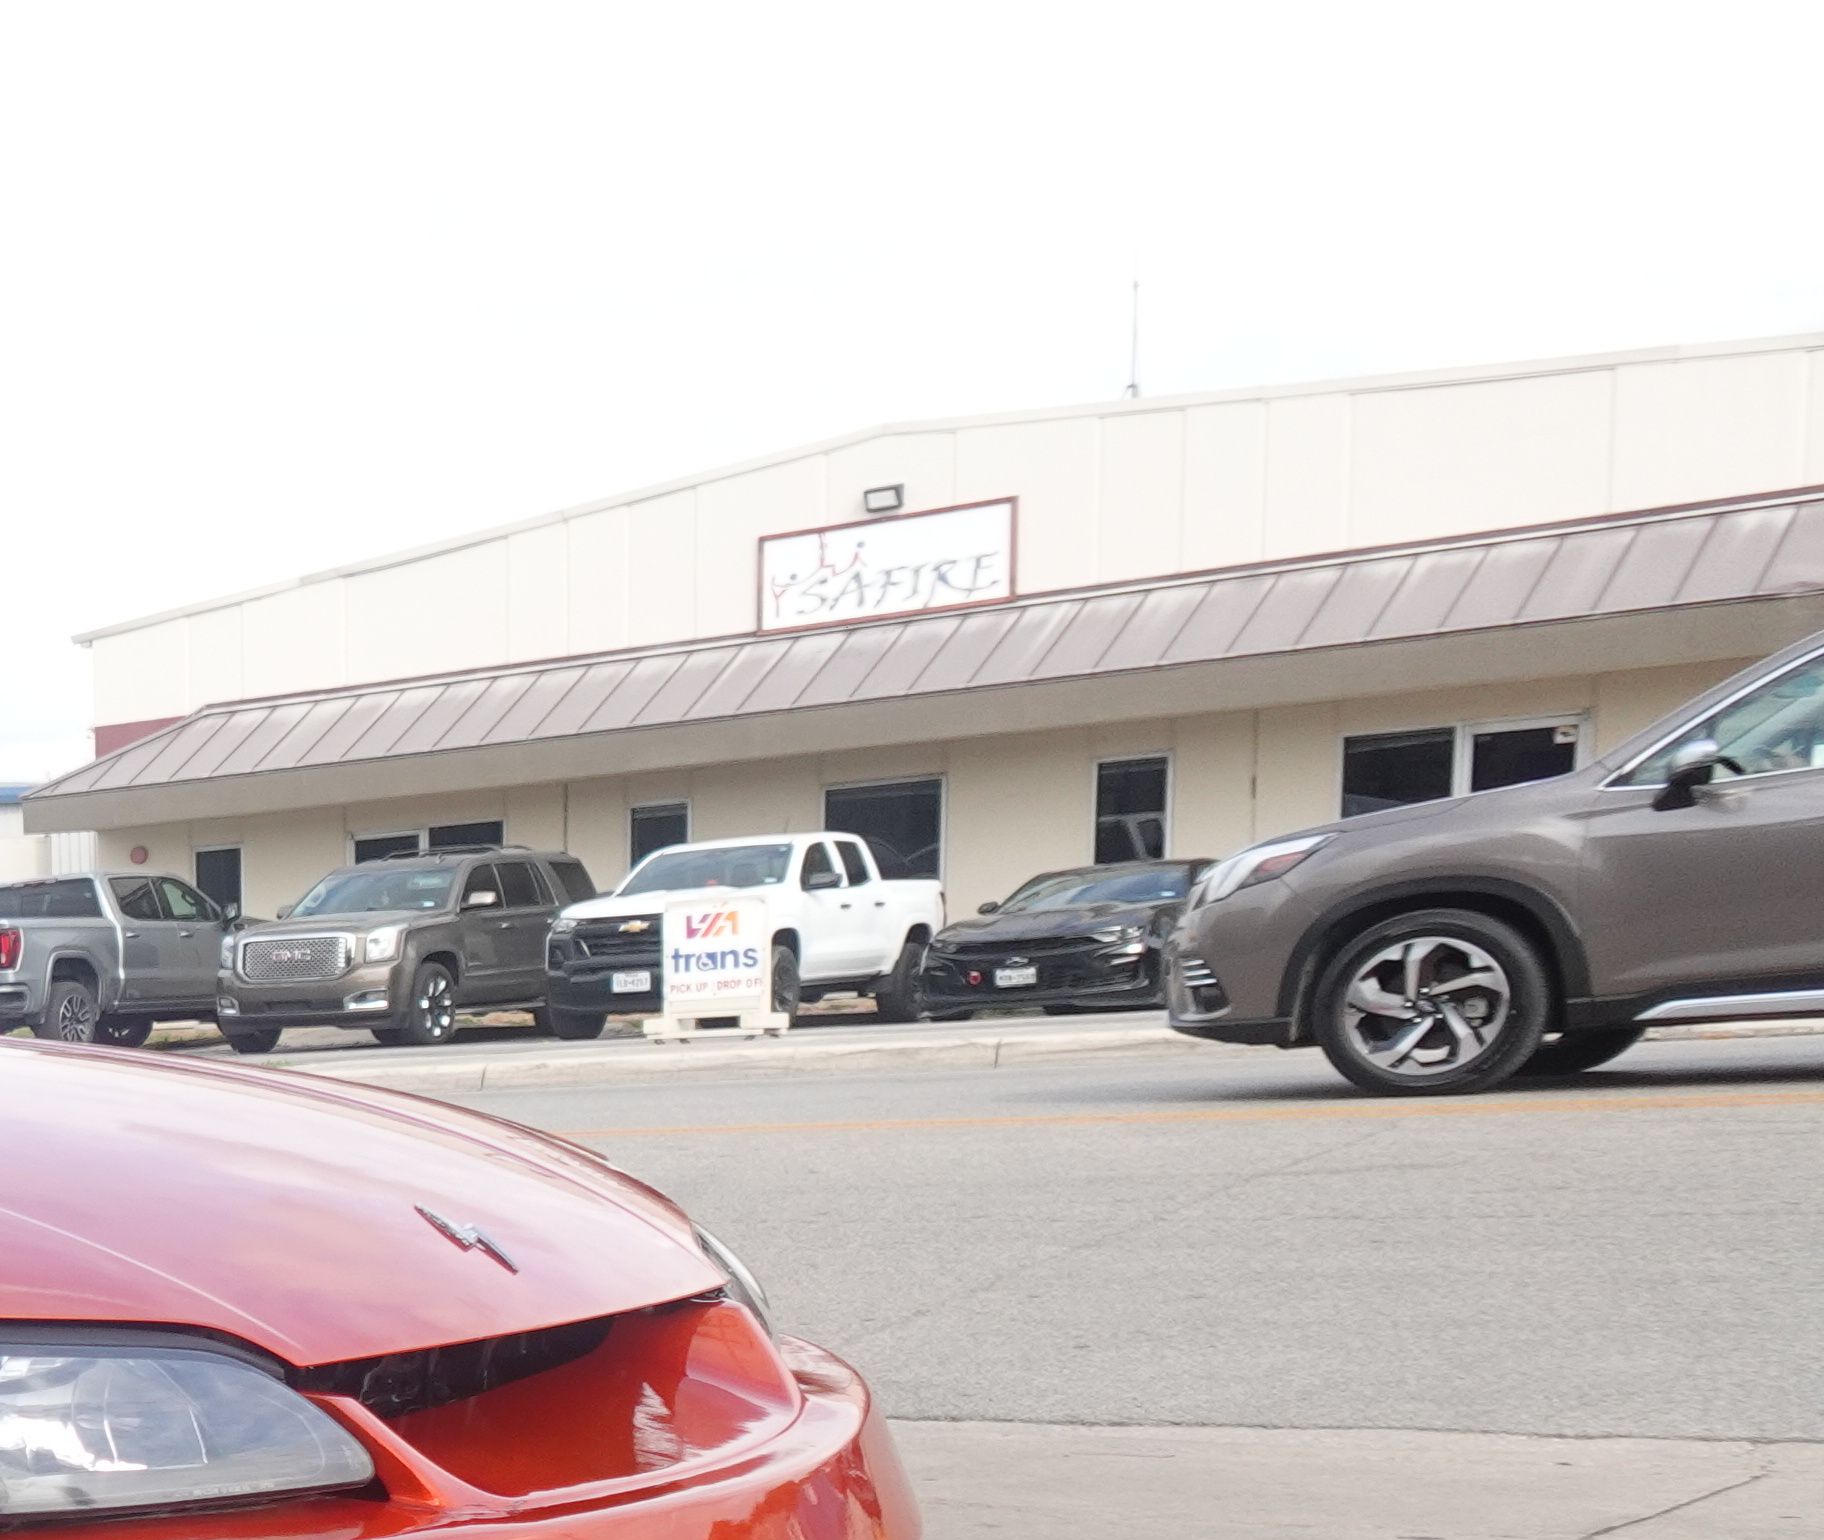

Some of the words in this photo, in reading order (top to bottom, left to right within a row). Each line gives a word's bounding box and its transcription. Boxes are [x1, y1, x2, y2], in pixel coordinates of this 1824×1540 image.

[671, 948, 759, 973] trans
[670, 984, 691, 993] PICK
[696, 982, 708, 992] UP
[717, 980, 741, 991] DROP
